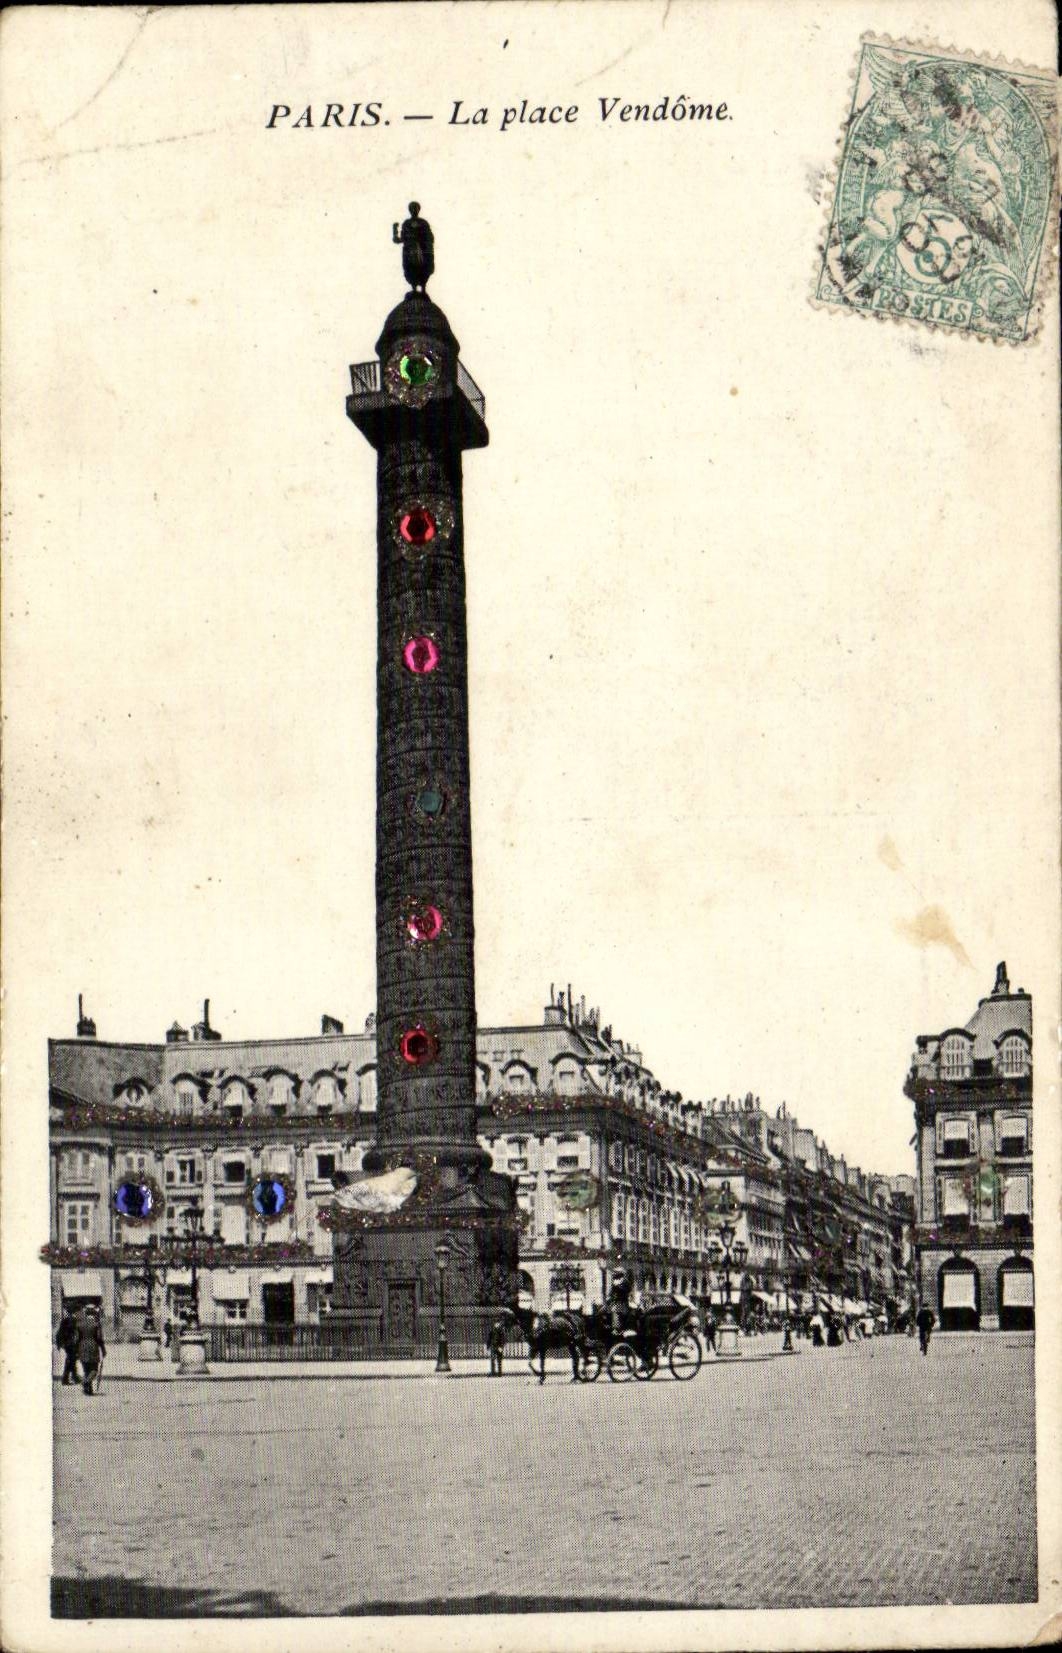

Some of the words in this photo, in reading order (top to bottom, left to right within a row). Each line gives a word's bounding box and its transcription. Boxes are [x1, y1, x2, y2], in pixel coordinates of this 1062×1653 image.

[265, 102, 391, 129] PARIS.
[448, 100, 489, 125] La
[499, 99, 579, 132] place
[598, 94, 735, 122] Vendôme.
[875, 288, 967, 322] POSTES
